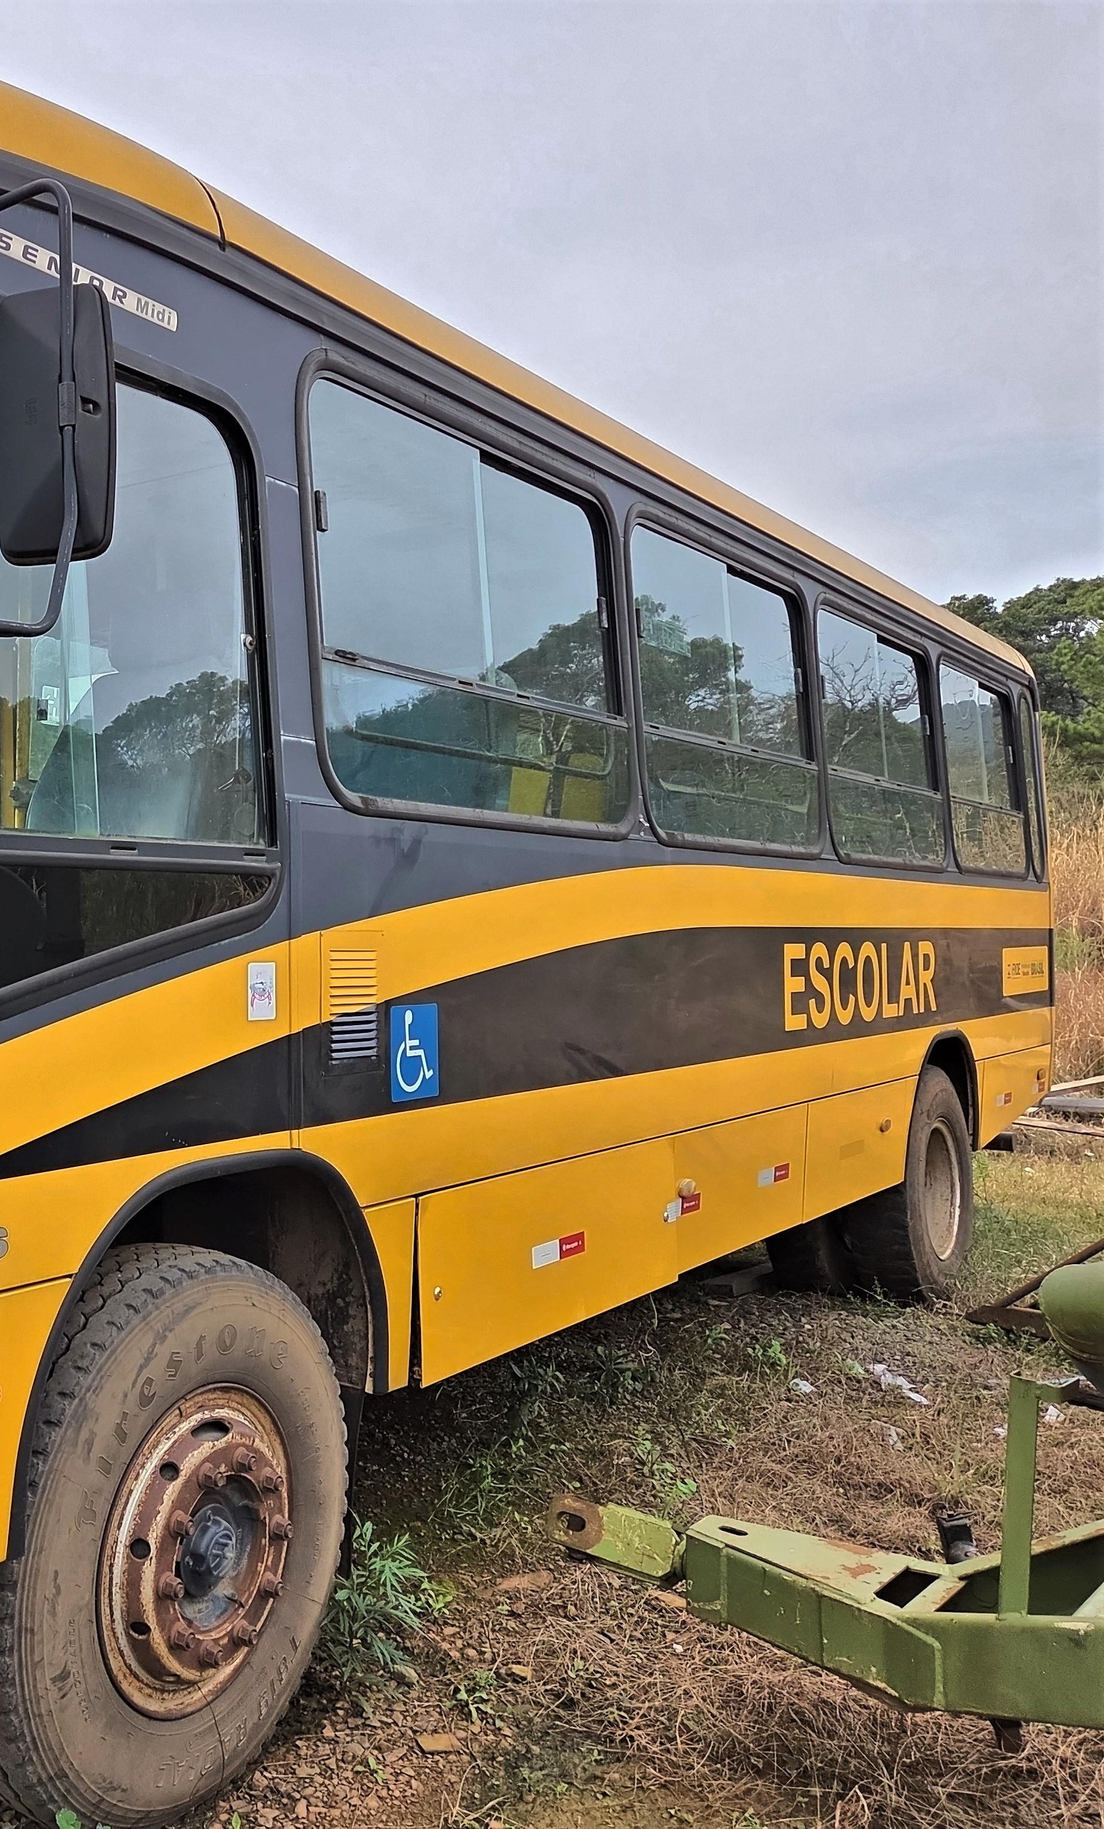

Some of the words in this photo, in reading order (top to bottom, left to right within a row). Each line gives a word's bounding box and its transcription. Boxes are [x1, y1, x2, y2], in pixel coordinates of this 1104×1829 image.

[135, 297, 173, 326] Midi
[783, 940, 937, 1032] ESCOLAR
[75, 1323, 288, 1532] Firestone
